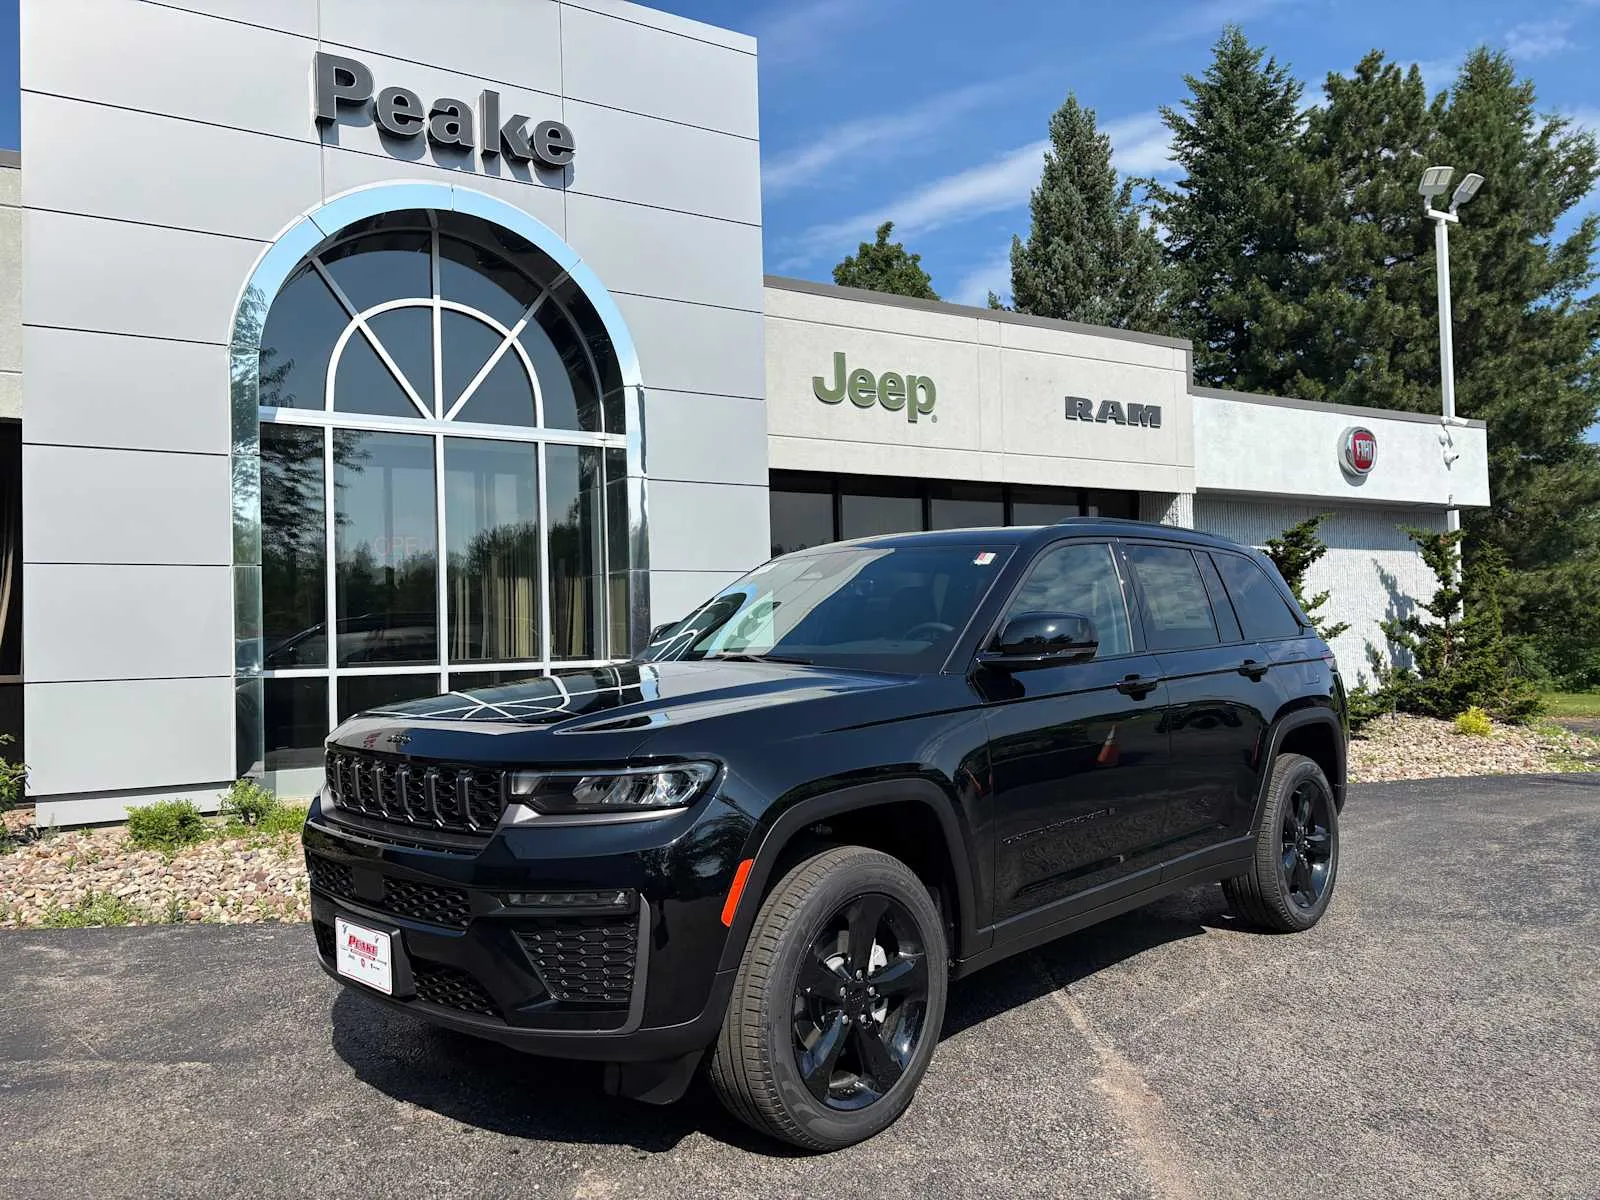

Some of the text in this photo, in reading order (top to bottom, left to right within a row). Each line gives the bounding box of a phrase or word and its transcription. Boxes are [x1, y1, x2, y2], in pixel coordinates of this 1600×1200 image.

[314, 51, 575, 168] Peake
[812, 352, 936, 424] Jeep
[1064, 396, 1162, 429] RAM
[1355, 439, 1374, 460] FIAT
